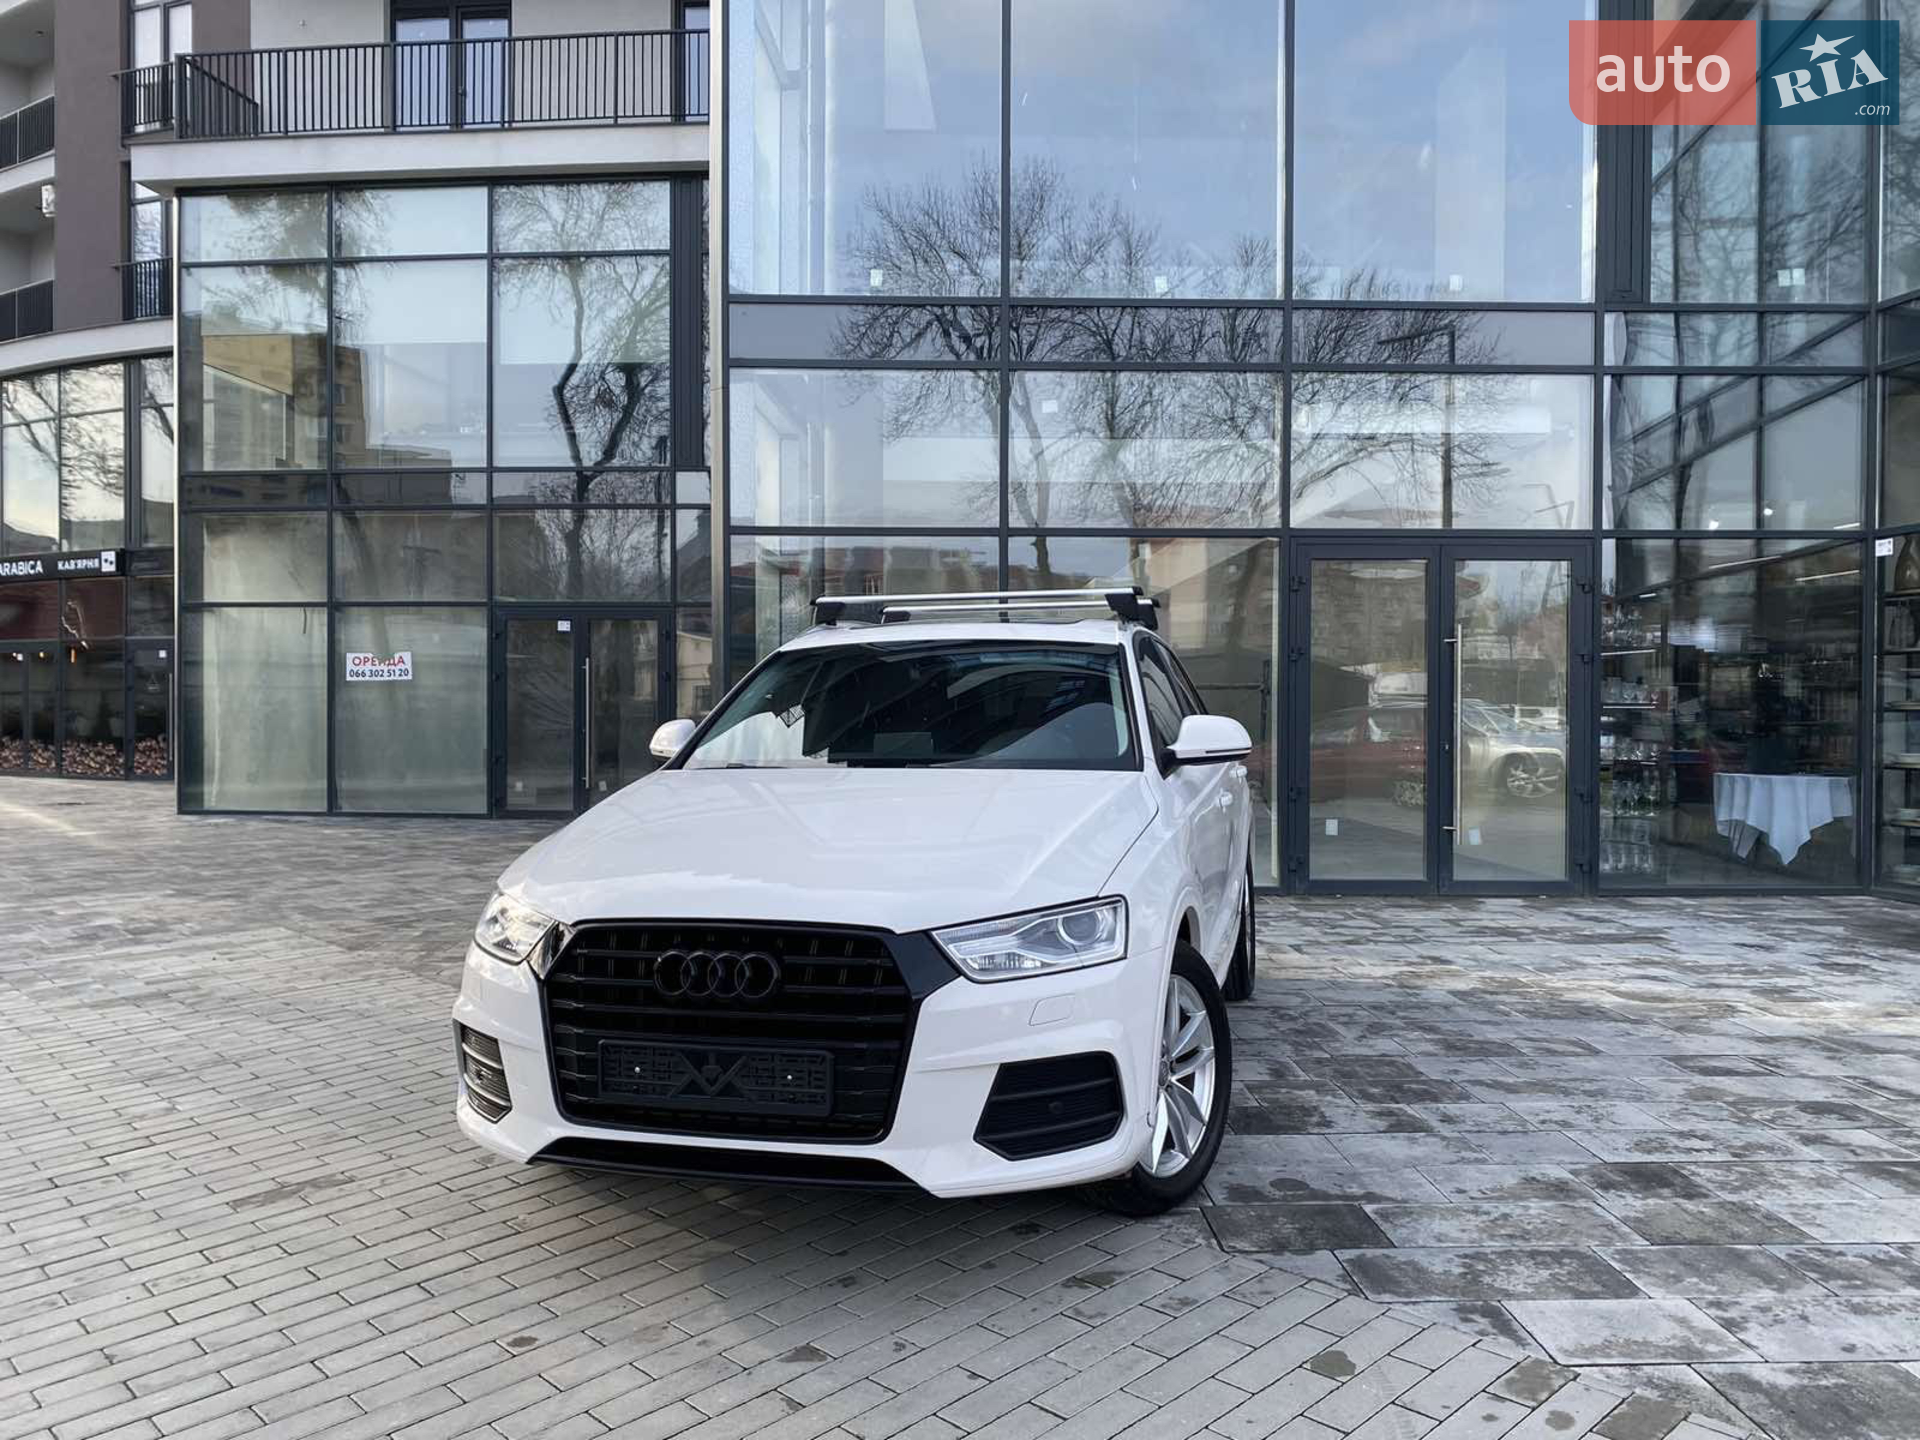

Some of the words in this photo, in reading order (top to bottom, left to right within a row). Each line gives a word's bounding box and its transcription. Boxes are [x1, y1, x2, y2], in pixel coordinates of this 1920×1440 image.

[0, 560, 43, 576] ARABICA
[349, 669, 366, 677] 066
[368, 669, 384, 677] 302
[387, 668, 396, 677] 51
[398, 668, 409, 677] 20
